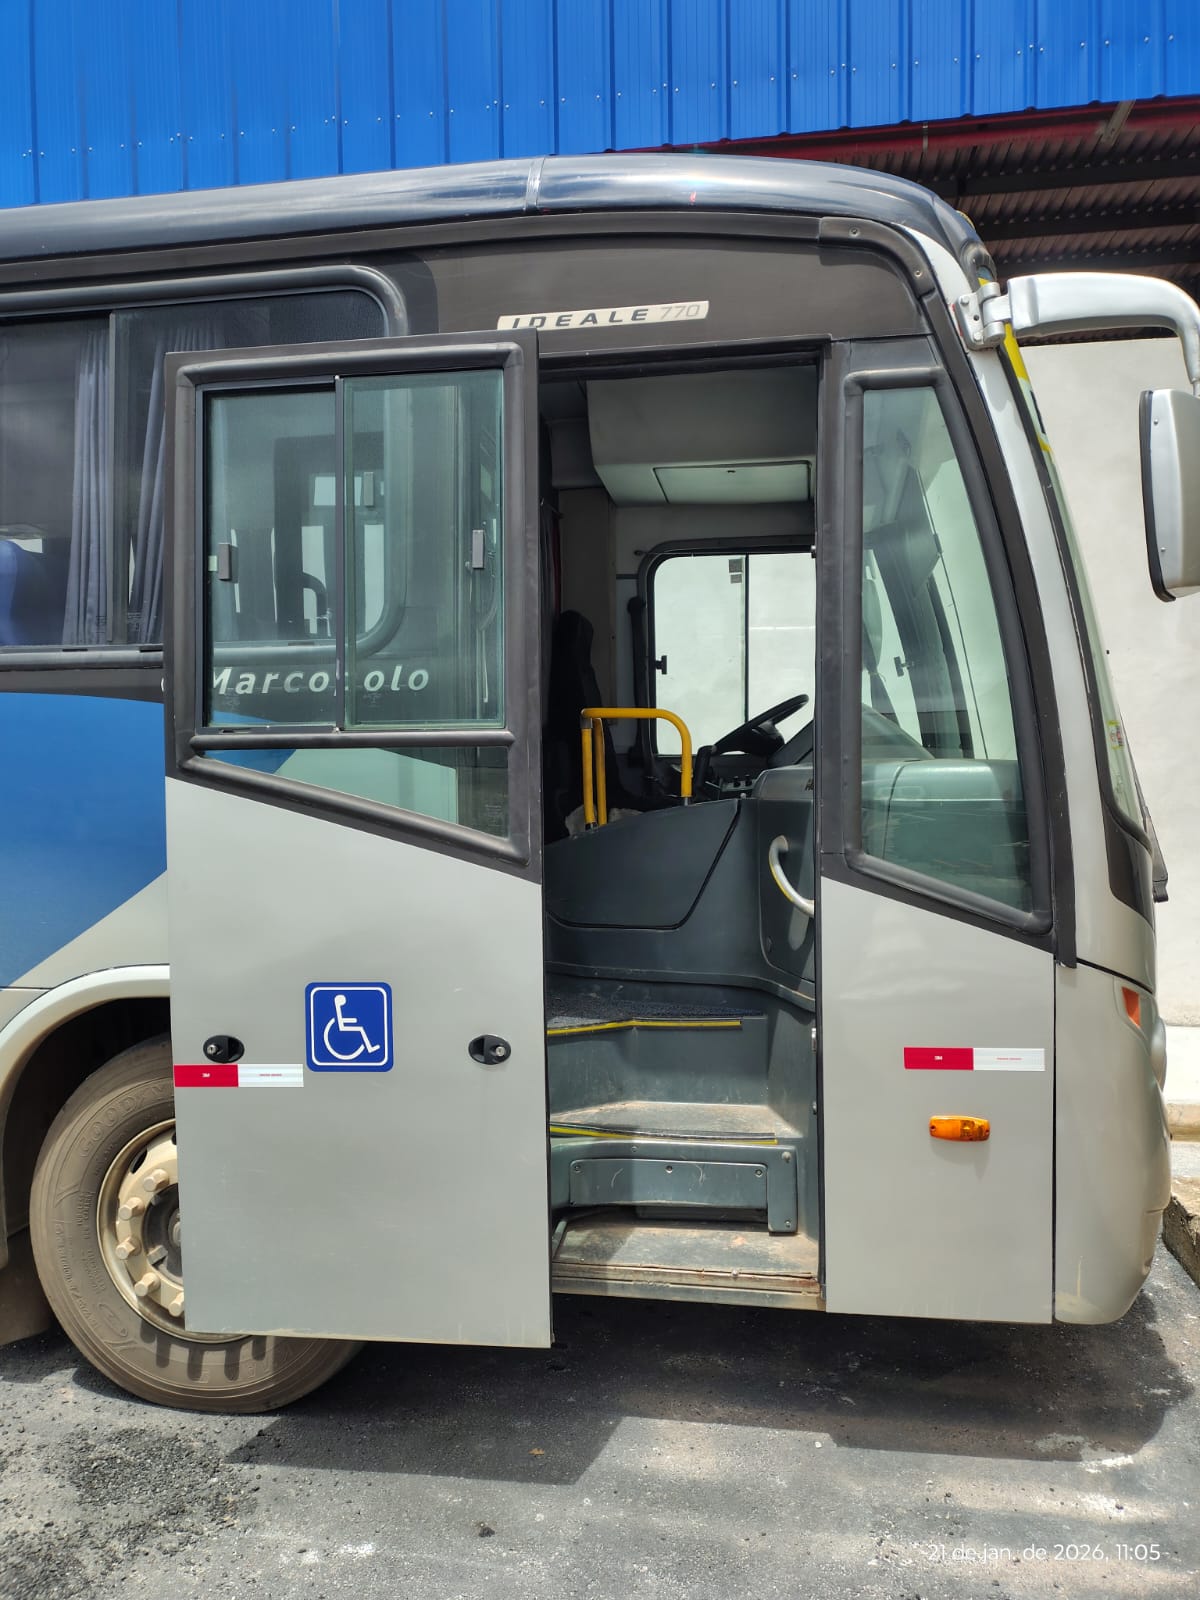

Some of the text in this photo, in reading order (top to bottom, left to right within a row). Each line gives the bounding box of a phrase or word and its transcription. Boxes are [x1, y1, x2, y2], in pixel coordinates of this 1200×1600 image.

[512, 304, 700, 329] IDEALE 770
[212, 665, 430, 695] Marcoolo
